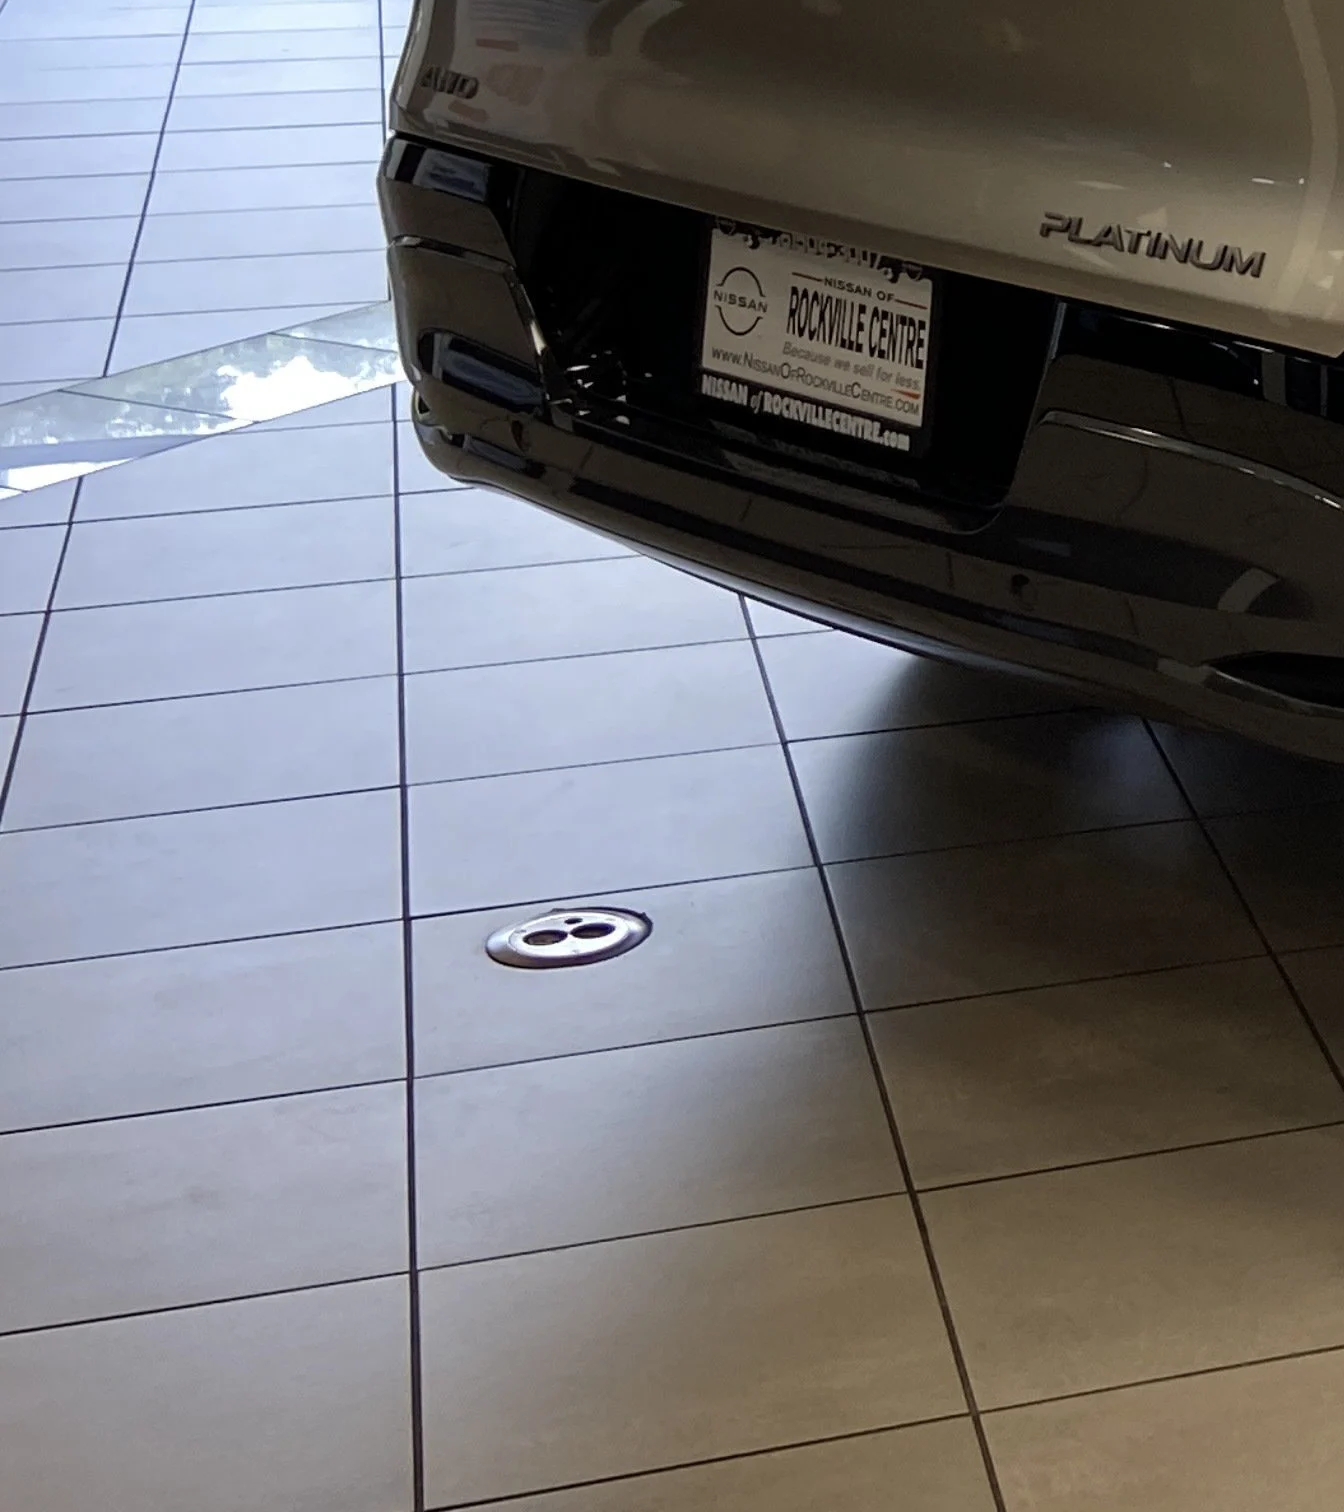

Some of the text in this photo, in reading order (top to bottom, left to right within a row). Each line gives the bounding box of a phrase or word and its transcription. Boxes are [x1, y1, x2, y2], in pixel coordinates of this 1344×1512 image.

[1039, 211, 1267, 278] PLATINUM
[713, 290, 768, 313] NISSAN
[824, 276, 895, 303] NISSAN OF
[786, 285, 926, 370] ROCKVILLE CENTRE
[782, 340, 832, 366] Because
[833, 359, 852, 372] we
[853, 362, 875, 378] sell
[876, 365, 894, 383] for
[701, 374, 749, 406] NISSAN
[750, 390, 765, 415] of
